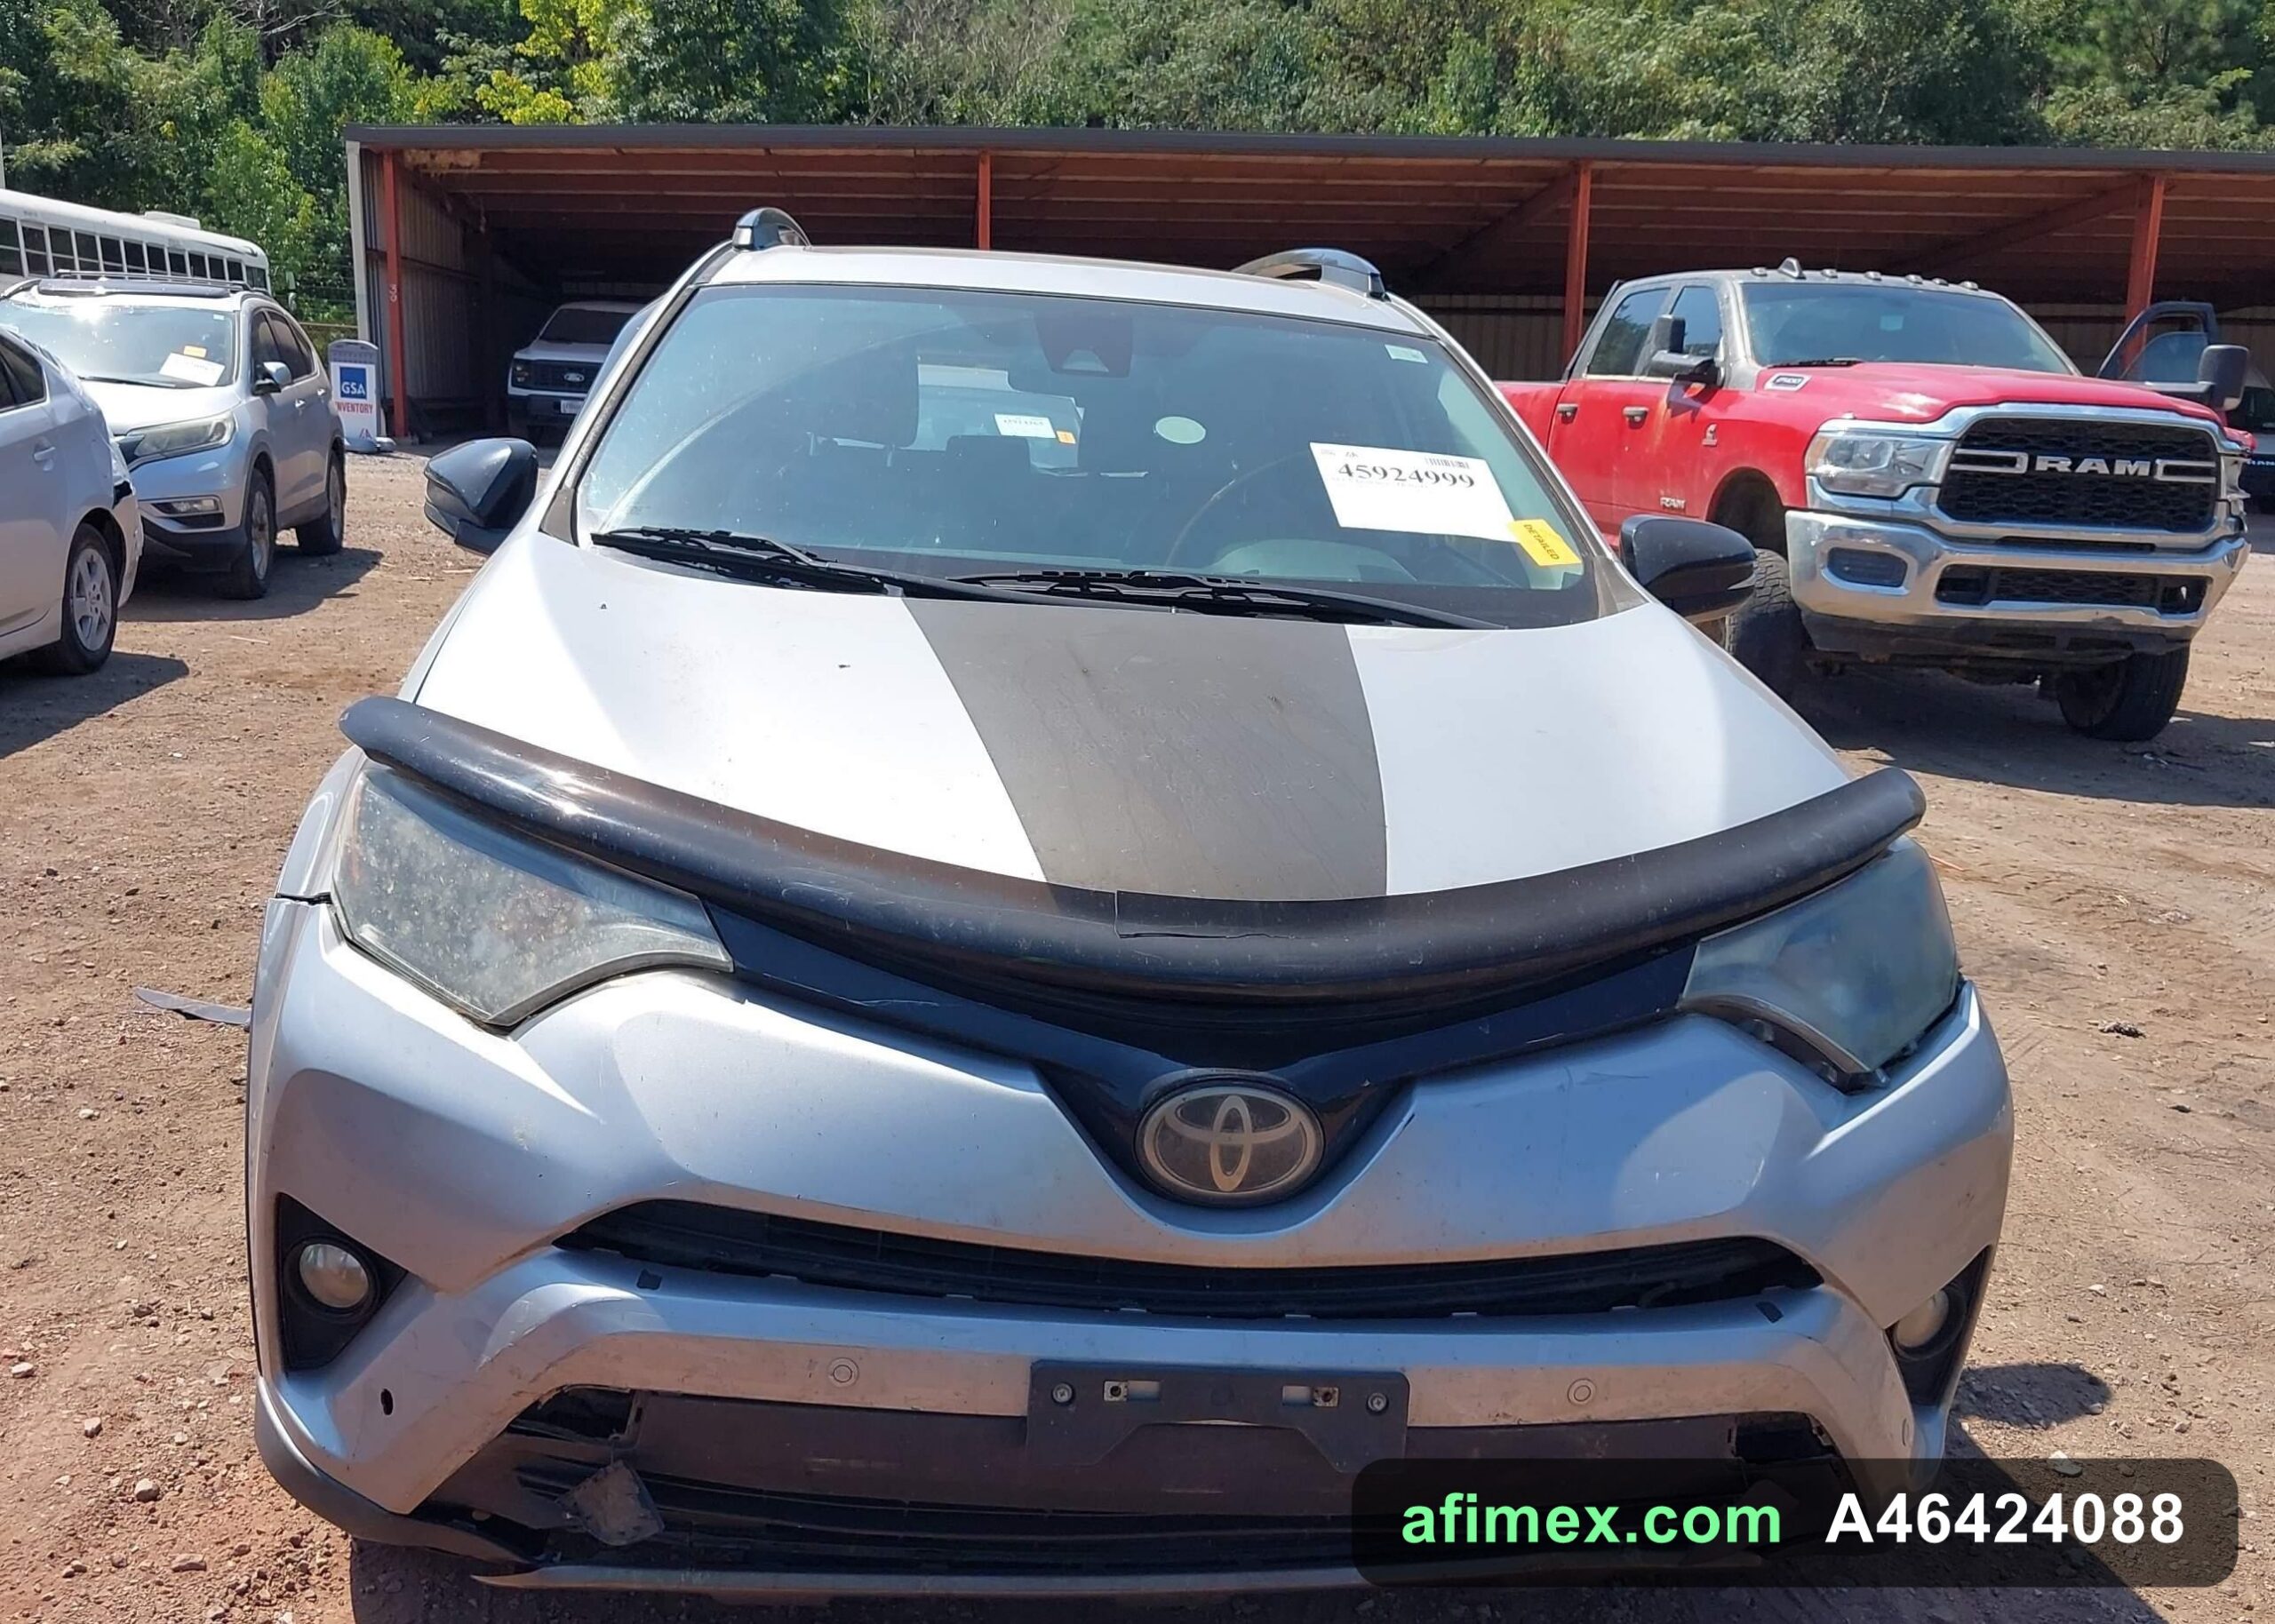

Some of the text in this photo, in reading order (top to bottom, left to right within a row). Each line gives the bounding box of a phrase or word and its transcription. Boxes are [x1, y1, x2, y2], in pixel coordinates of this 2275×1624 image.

[341, 381, 366, 395] GSA
[1337, 462, 1475, 489] 45924999
[2035, 455, 2151, 477] RAM
[1523, 524, 1561, 561] DETAILED
